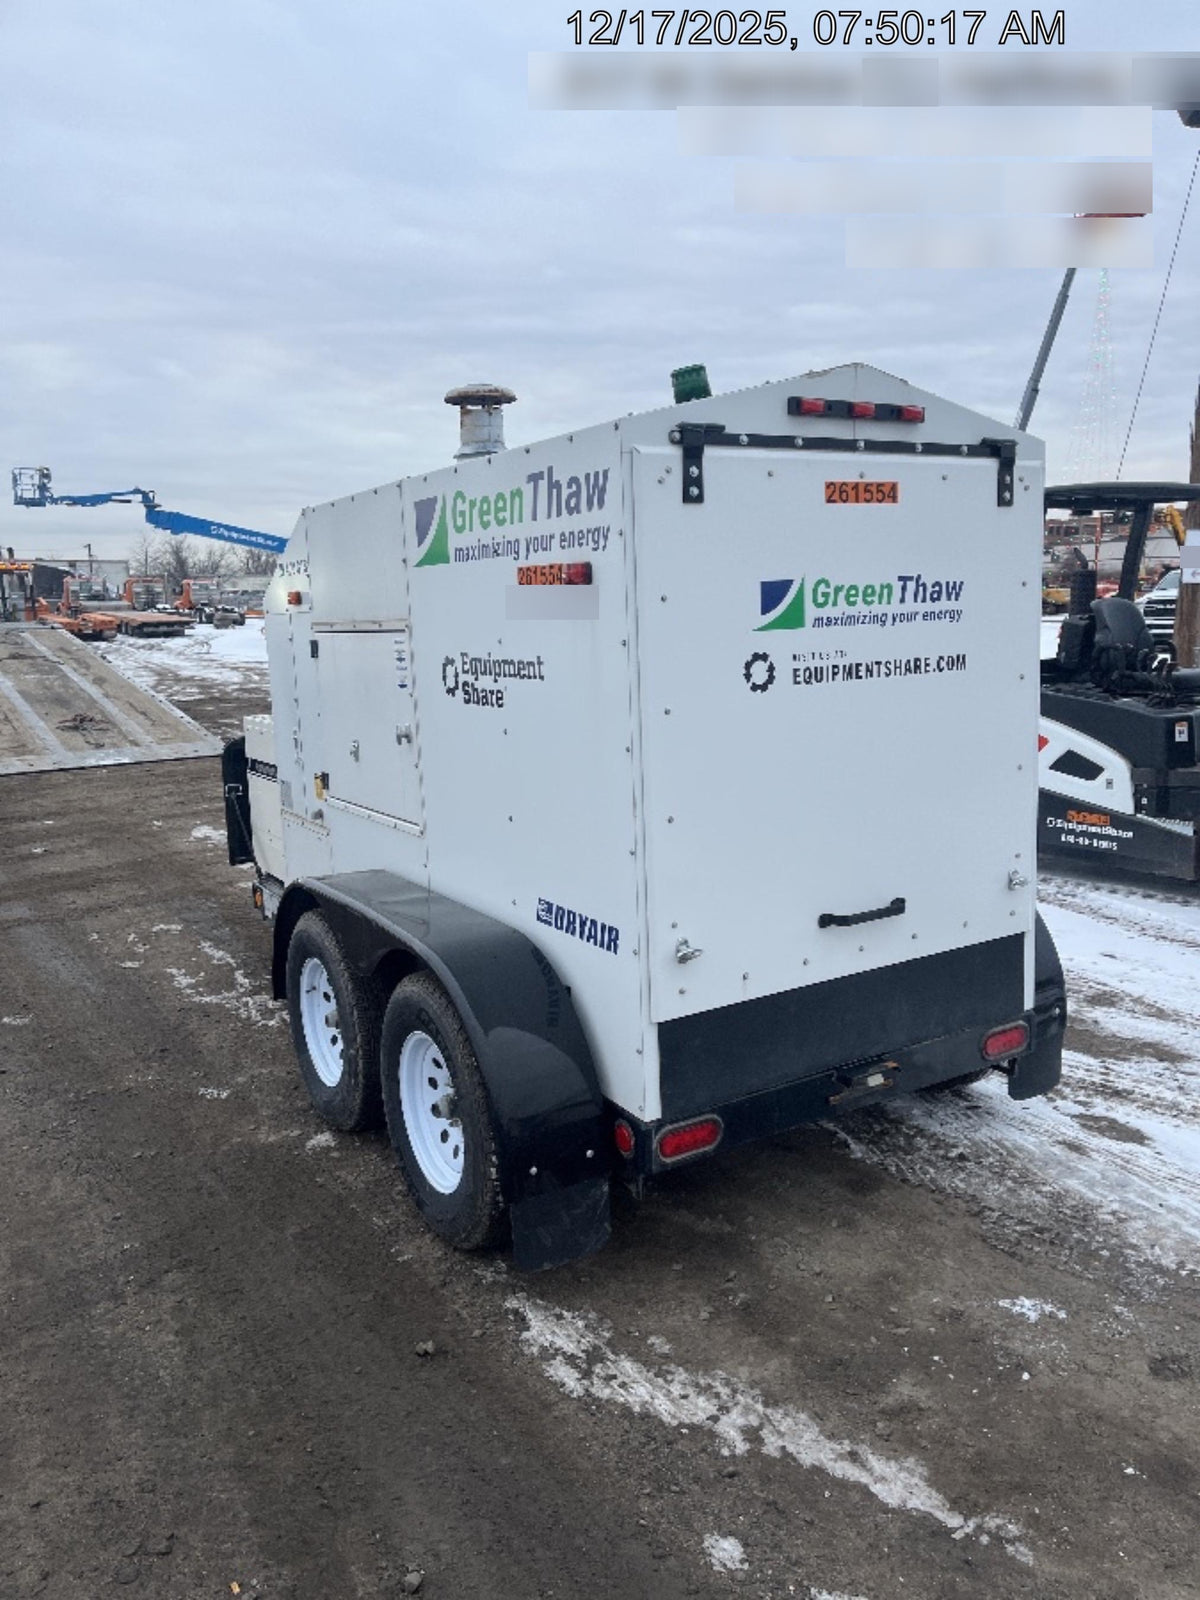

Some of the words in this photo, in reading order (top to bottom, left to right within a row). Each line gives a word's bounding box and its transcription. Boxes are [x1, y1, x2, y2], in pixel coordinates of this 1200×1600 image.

[825, 481, 899, 503] 261554
[454, 533, 520, 561] maximizing
[525, 532, 556, 560] your
[559, 525, 611, 552] energy
[517, 563, 563, 585] 261554
[811, 611, 888, 629] maximizing
[891, 611, 919, 626] your
[922, 607, 963, 623] energy
[460, 652, 545, 683] Equipment
[792, 654, 967, 686] EQUIPMENTSHARE.COM
[462, 680, 505, 708] Share
[554, 904, 619, 955] DRYAIR
